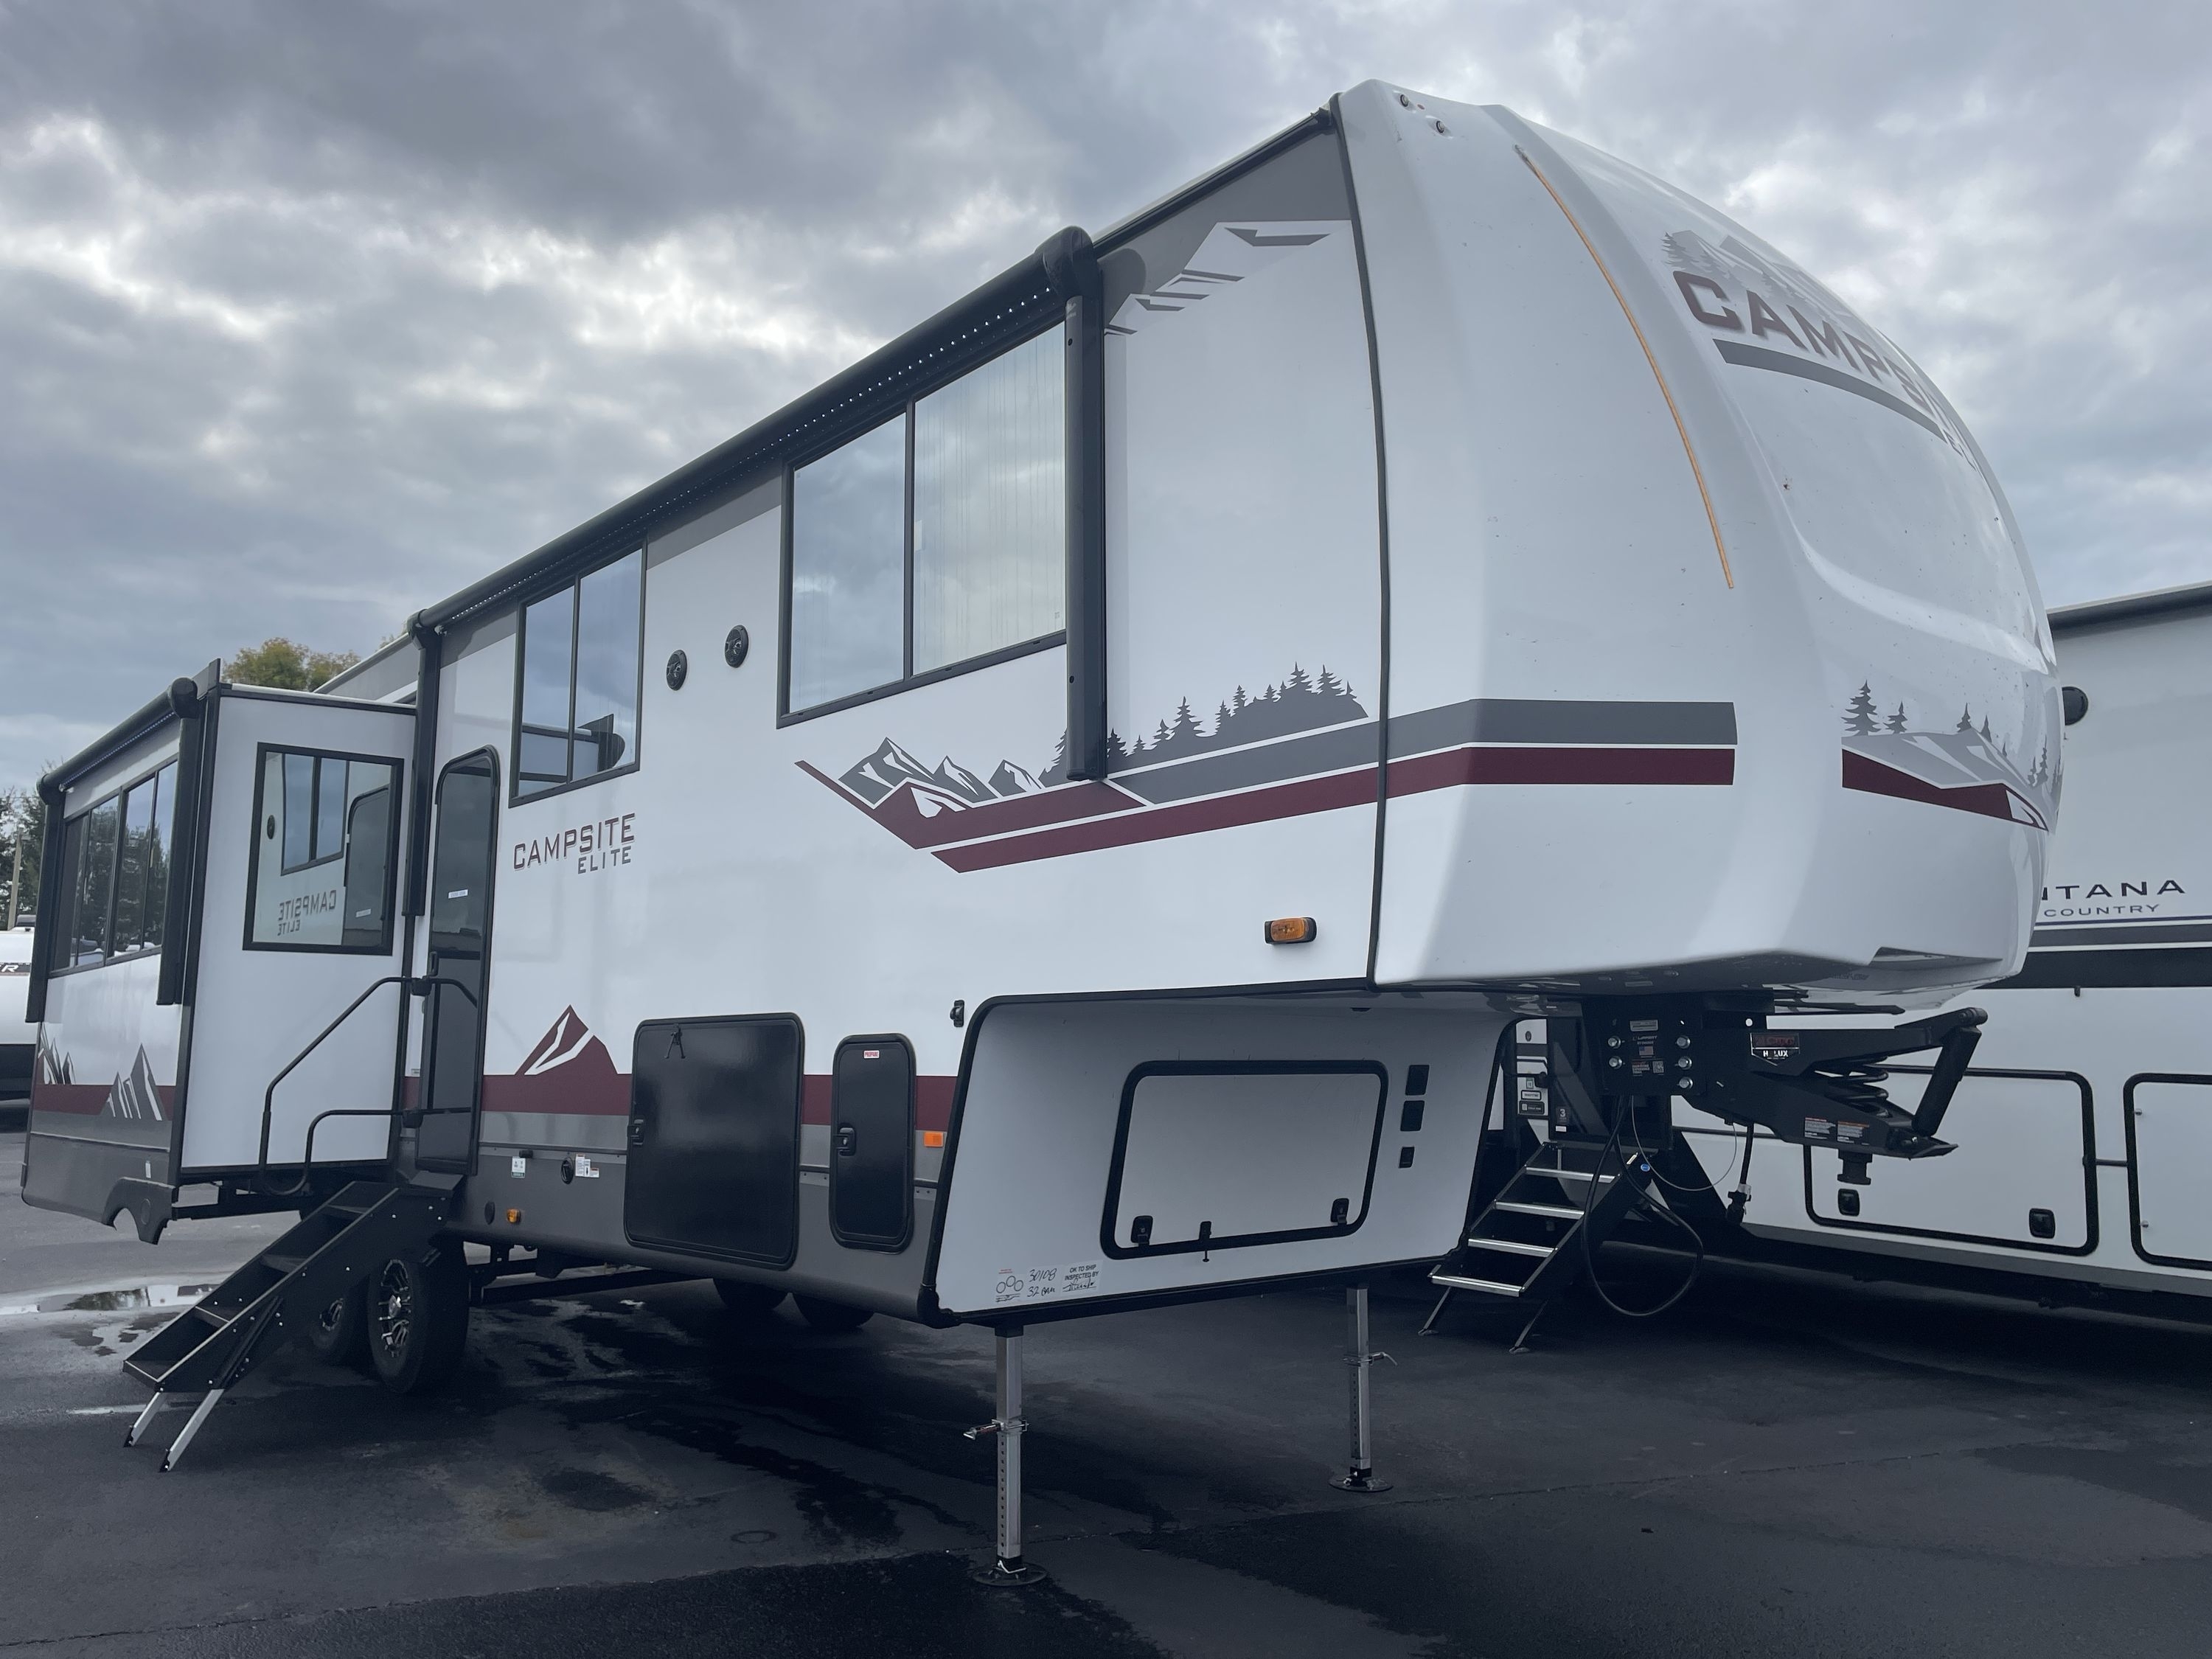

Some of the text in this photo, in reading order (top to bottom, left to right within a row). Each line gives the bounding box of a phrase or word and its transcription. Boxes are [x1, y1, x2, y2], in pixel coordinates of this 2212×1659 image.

[513, 813, 635, 869] CAMPSITE
[578, 846, 632, 874] ELITE
[2042, 880, 2185, 900] TANA
[2044, 904, 2160, 917] COUNTRY
[1065, 1272, 1091, 1281] INSPECTED
